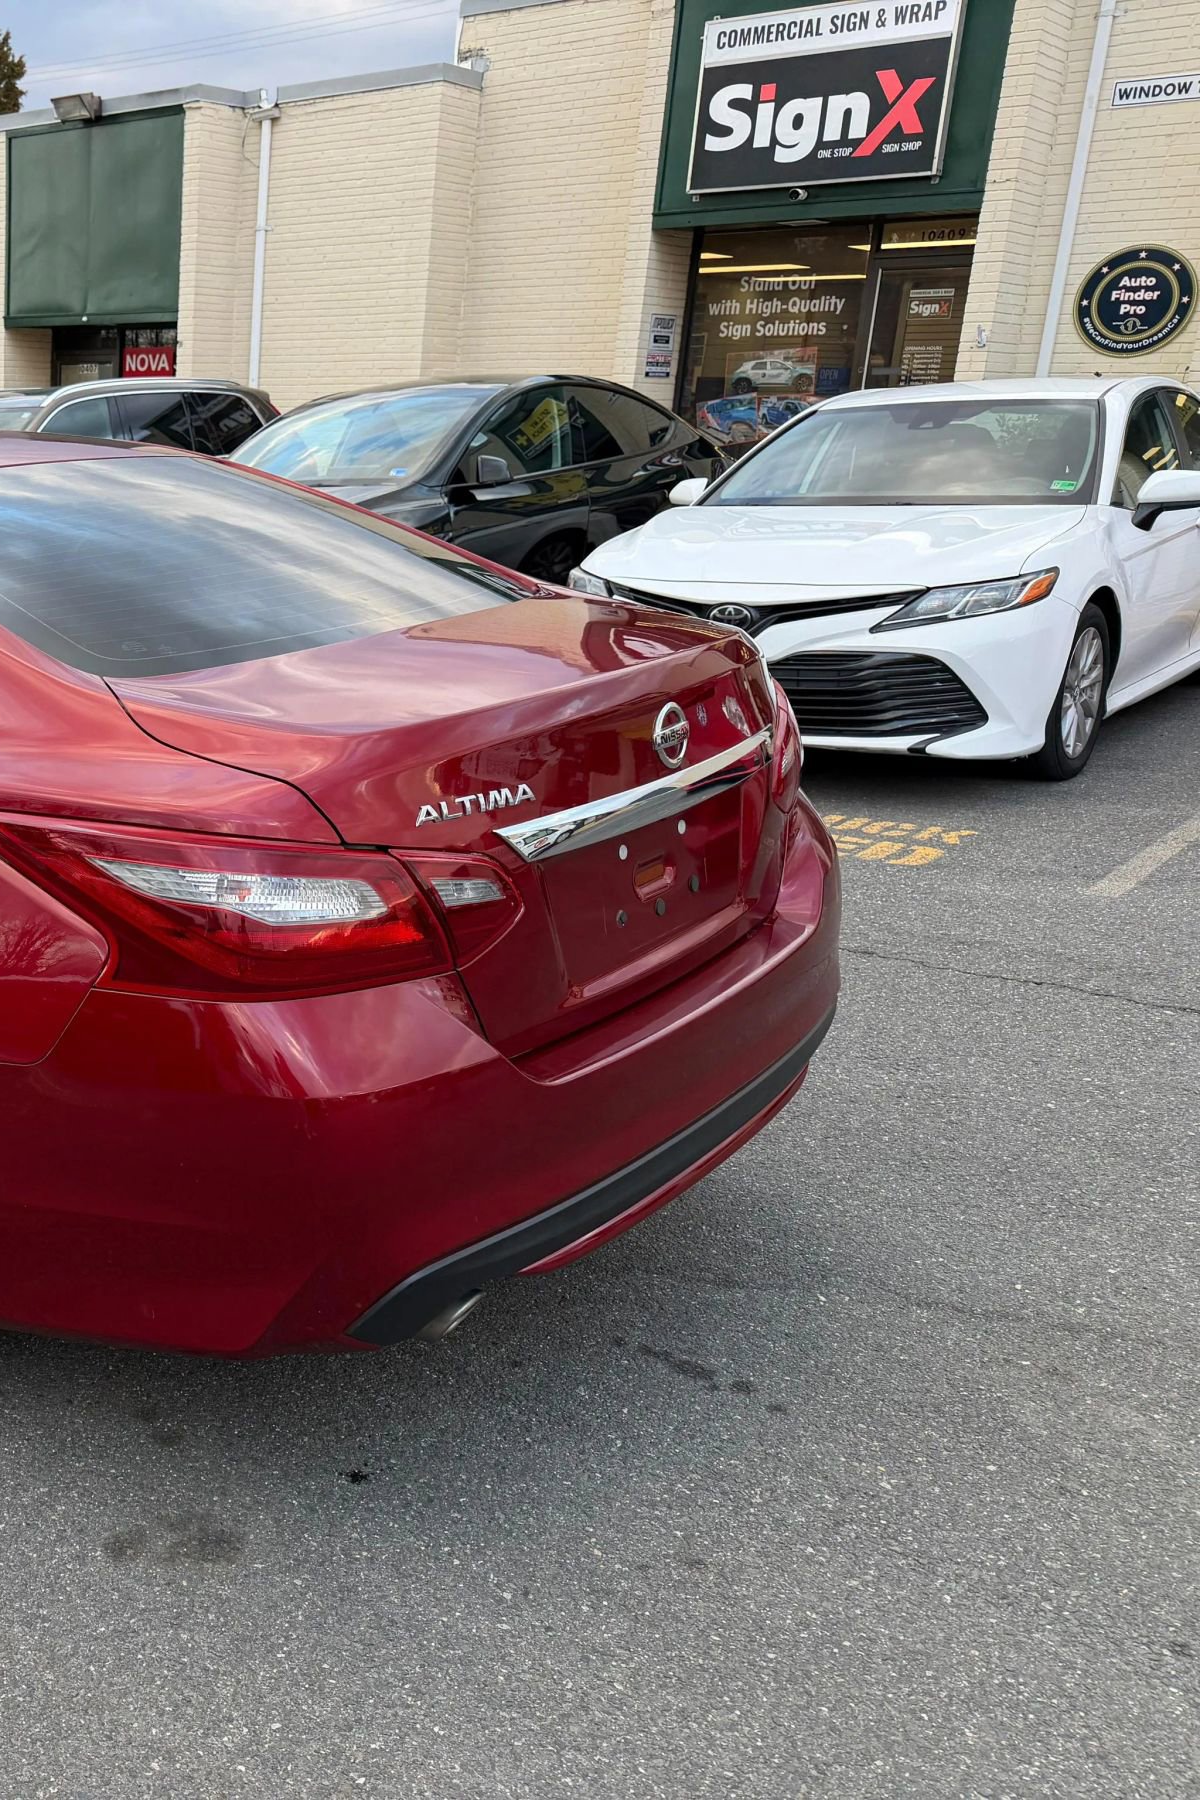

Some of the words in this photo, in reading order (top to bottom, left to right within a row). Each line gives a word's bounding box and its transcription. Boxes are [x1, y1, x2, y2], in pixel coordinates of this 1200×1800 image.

[716, 18, 823, 50] COMMERCIAL
[828, 10, 870, 34] SIGN
[875, 8, 887, 29] &
[894, 1, 947, 26] WRAP
[1119, 81, 1193, 100] WINDOW
[704, 69, 936, 163] SignX
[817, 149, 832, 159] ONE
[833, 147, 853, 157] STOP
[881, 142, 900, 153] SIGN
[901, 141, 922, 151] SHOP
[921, 228, 966, 241] 10409
[740, 274, 784, 292] Stand
[788, 273, 816, 290] Out
[1119, 276, 1157, 287] Auto
[1111, 289, 1160, 301] Finder
[708, 300, 740, 316] with
[745, 296, 845, 317] High-Quality
[1120, 304, 1146, 315] Pro
[719, 322, 751, 340] Sign
[755, 320, 826, 337] Solutions
[1083, 315, 1181, 349] #WeCanFindYourDreamCar
[125, 354, 170, 372] NOVA
[819, 368, 839, 380] OPEN
[660, 726, 689, 745] NISSAN
[415, 783, 536, 827] ALTIMA
